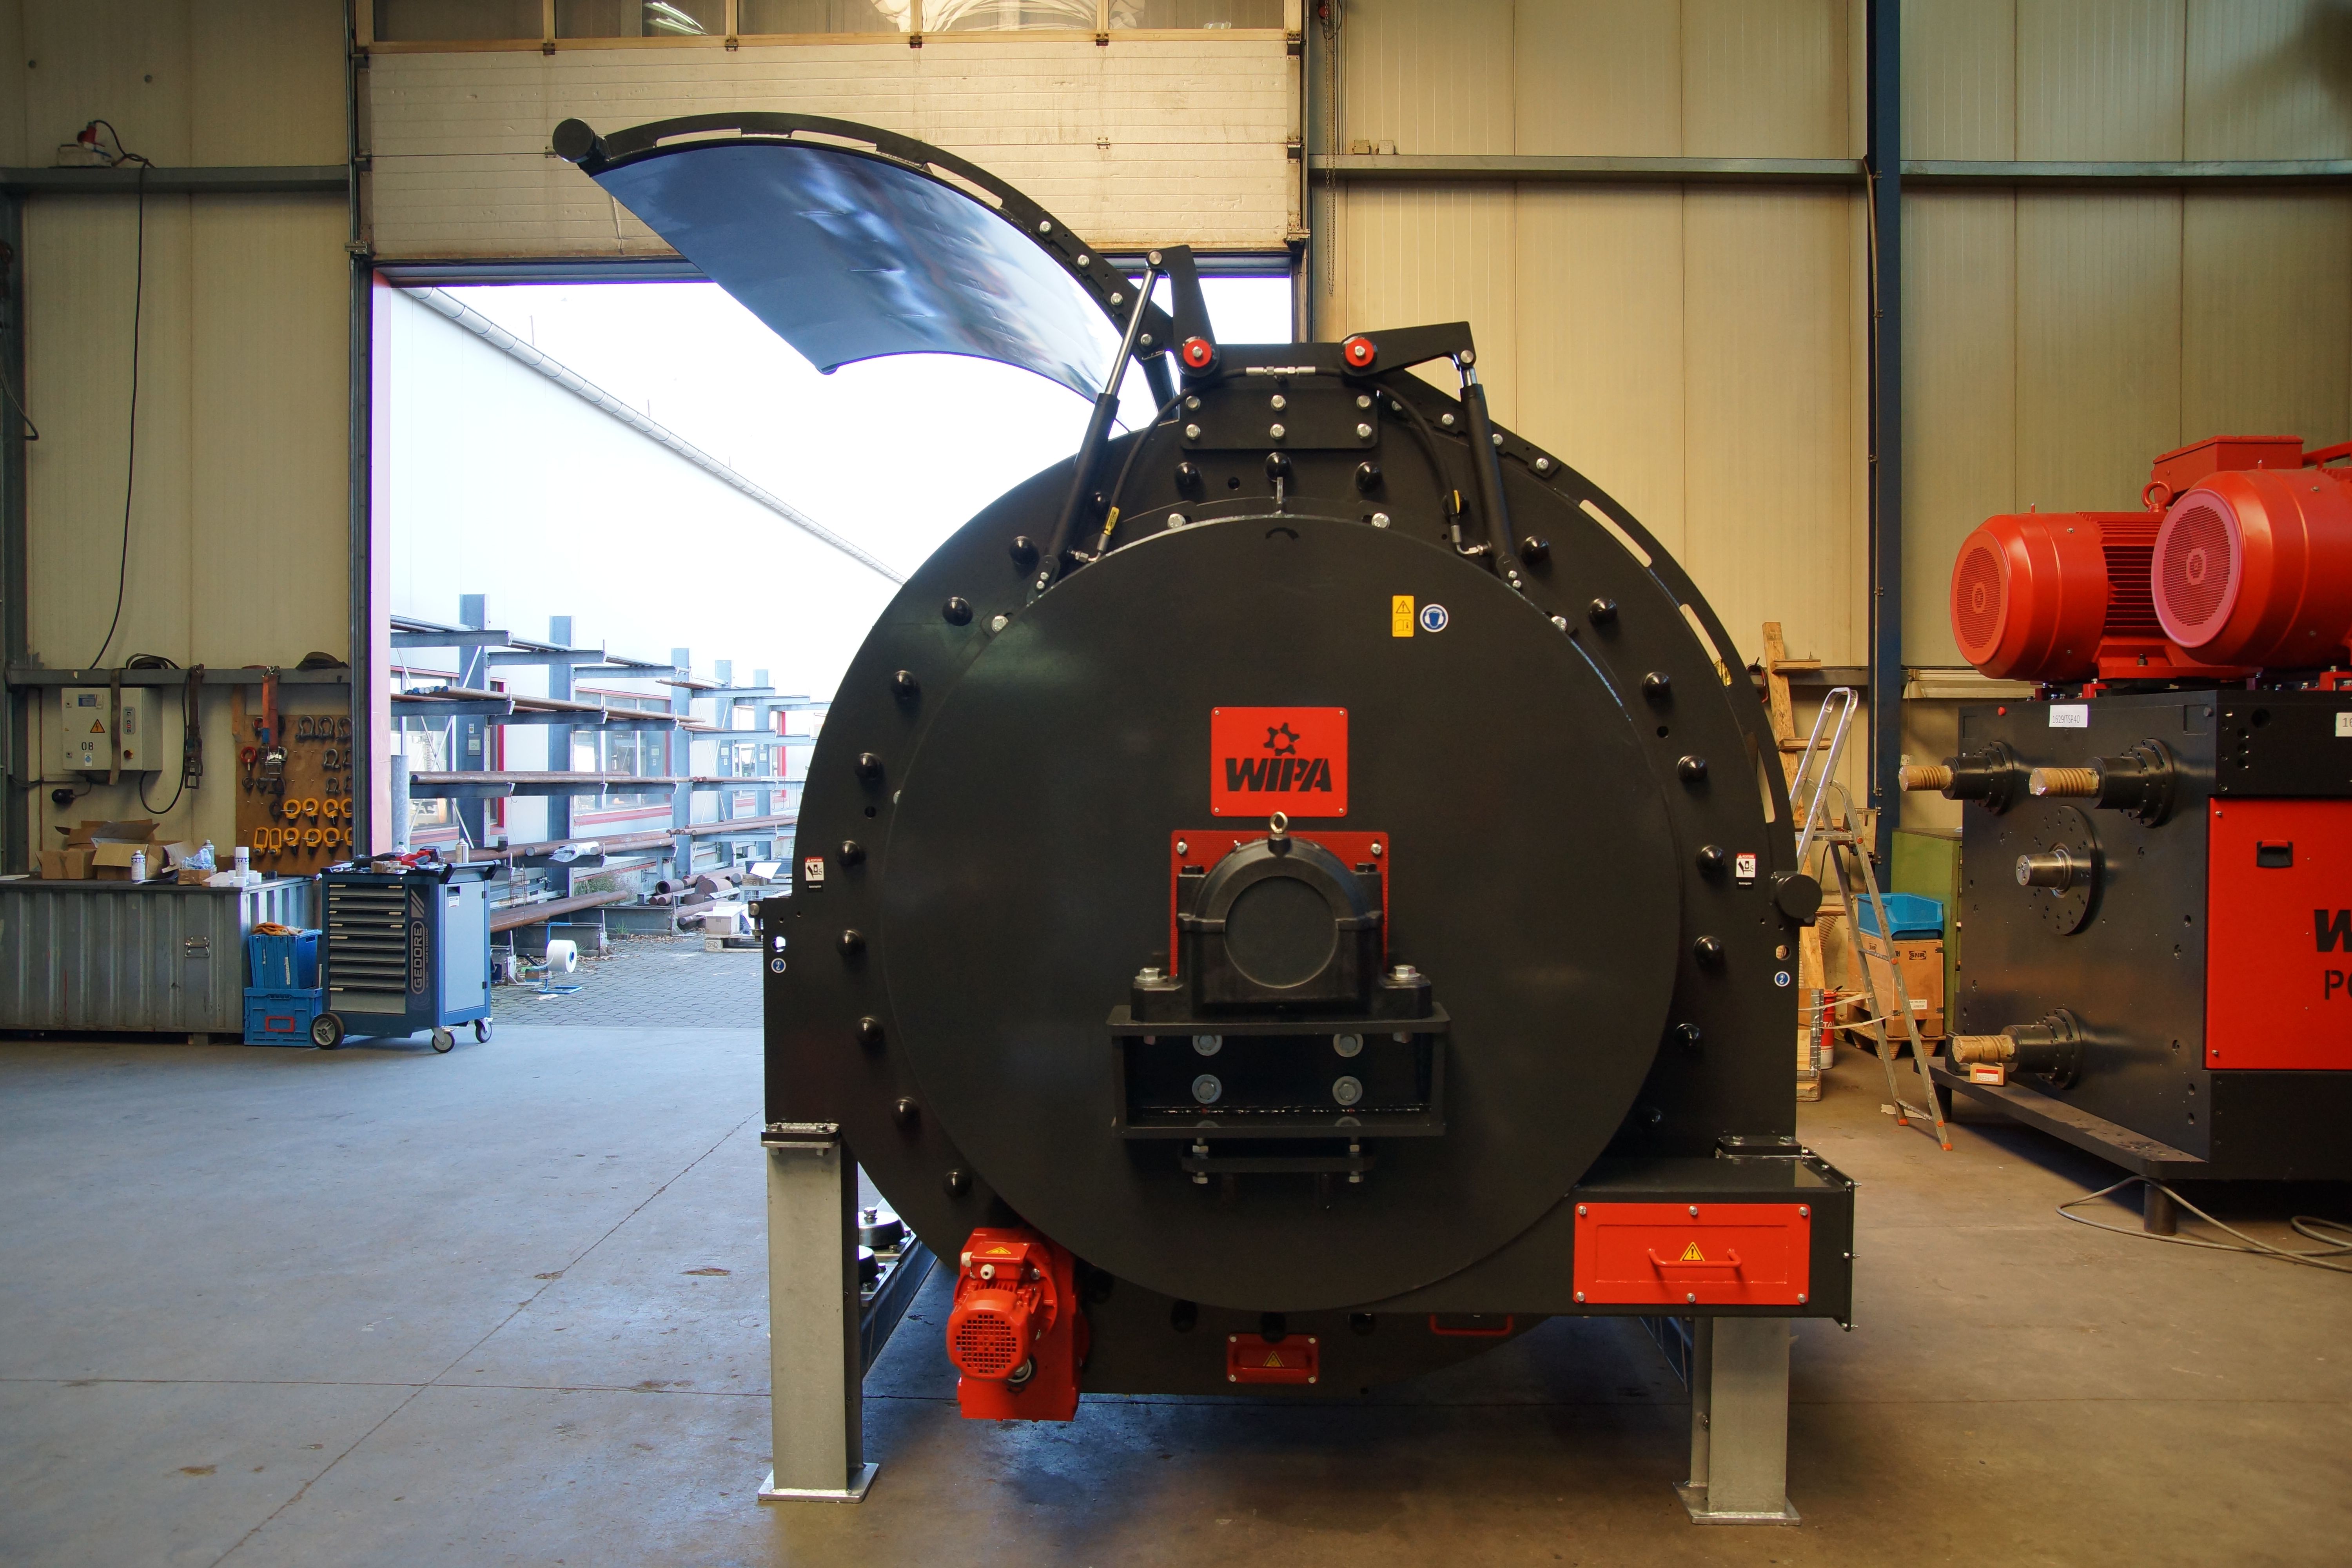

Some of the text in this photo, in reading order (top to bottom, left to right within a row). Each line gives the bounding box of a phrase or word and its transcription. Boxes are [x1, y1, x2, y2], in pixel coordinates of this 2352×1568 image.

[82, 742, 94, 751] 08
[1225, 758, 1332, 792] WIPA
[414, 927, 422, 988] GEDORE
[2325, 970, 2352, 1000] P
